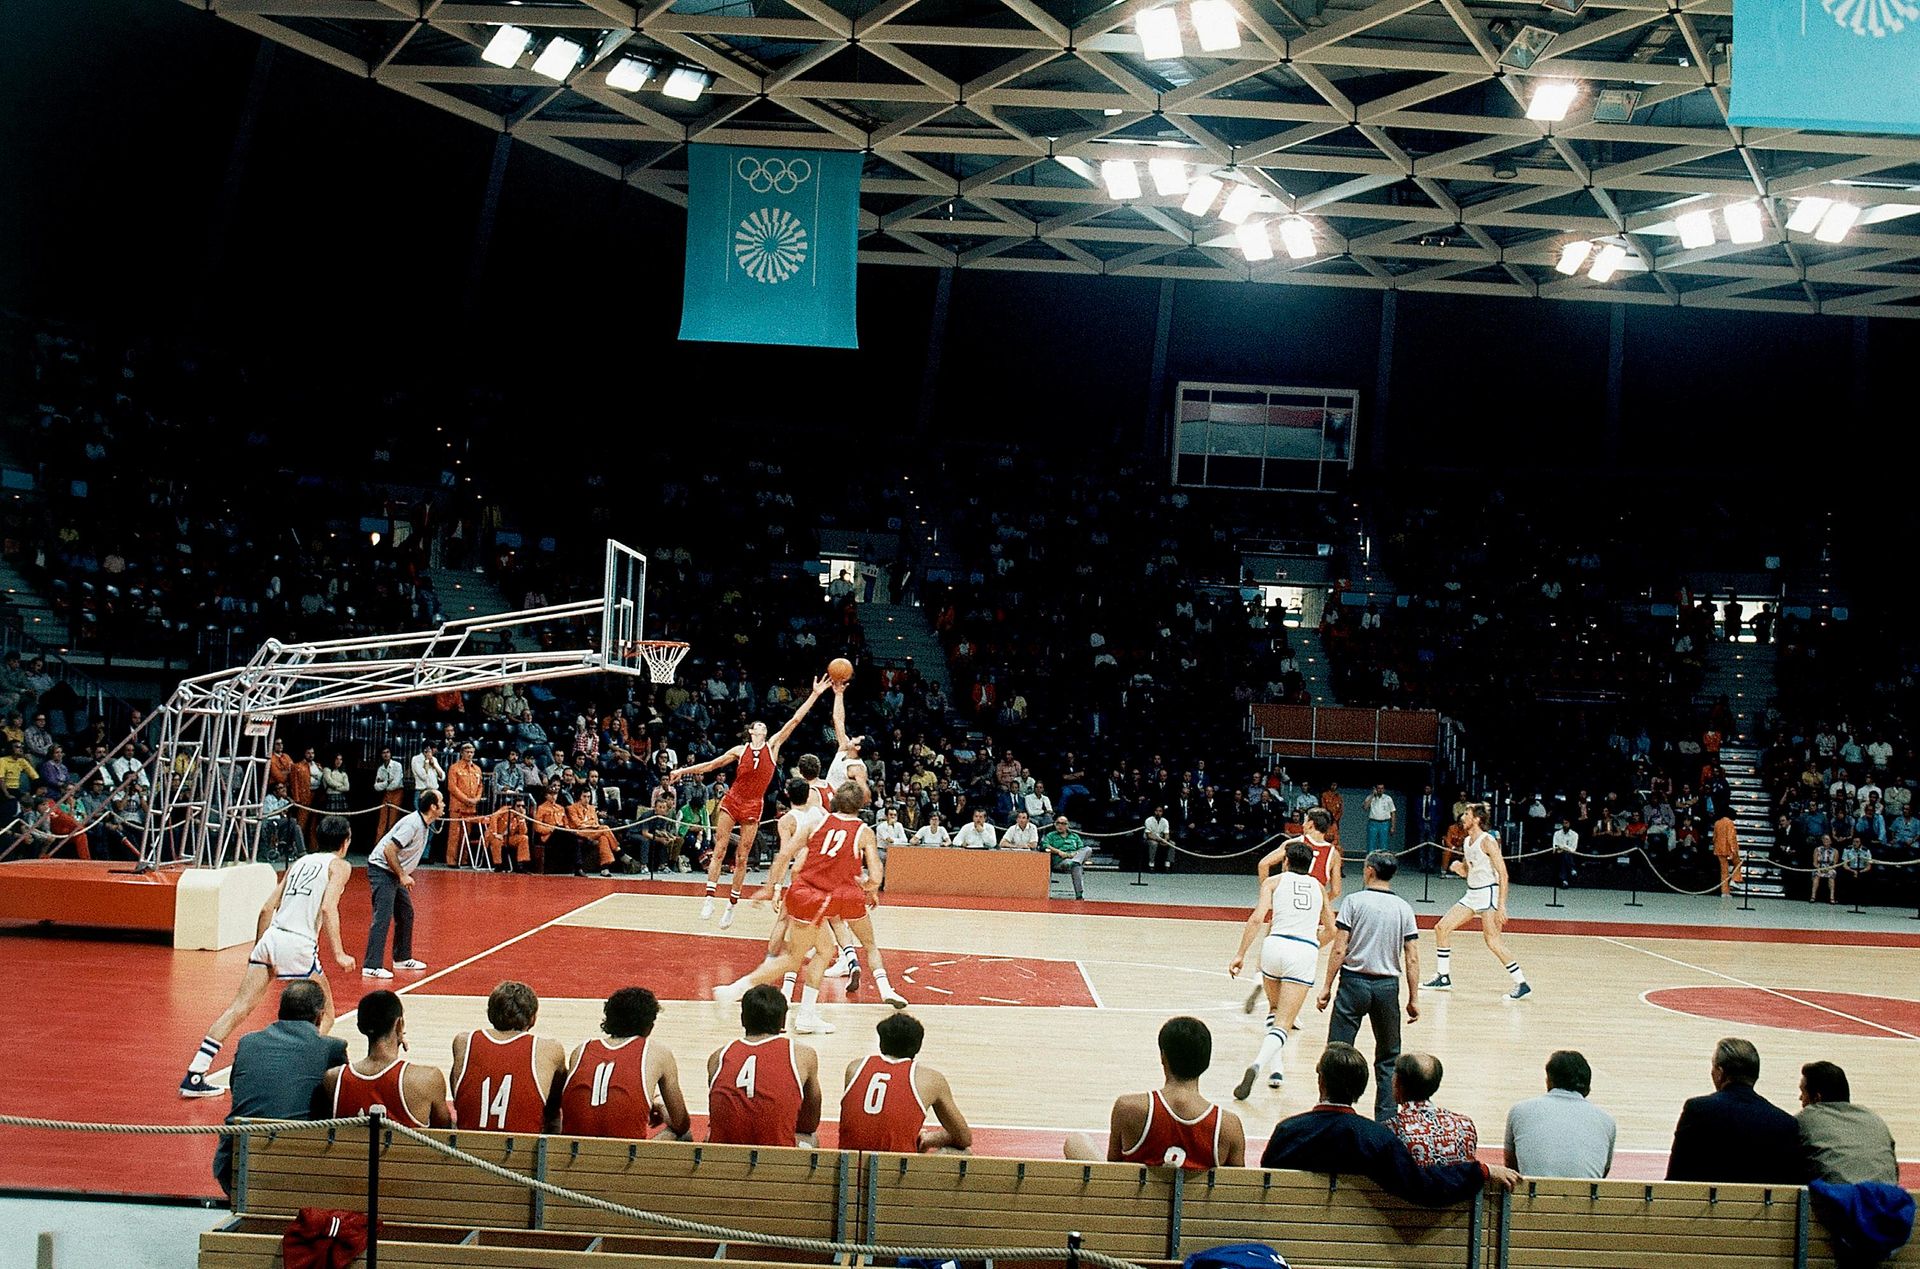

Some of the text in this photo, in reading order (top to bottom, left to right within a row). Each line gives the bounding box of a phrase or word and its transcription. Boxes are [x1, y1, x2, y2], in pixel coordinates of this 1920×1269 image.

[752, 757, 760, 770] 7
[820, 829, 848, 858] 12
[285, 863, 323, 896] 12
[1293, 880, 1313, 911] 5
[590, 1061, 616, 1107] 11
[735, 1055, 757, 1099] 4
[864, 1072, 892, 1115] 6
[478, 1074, 513, 1130] 14
